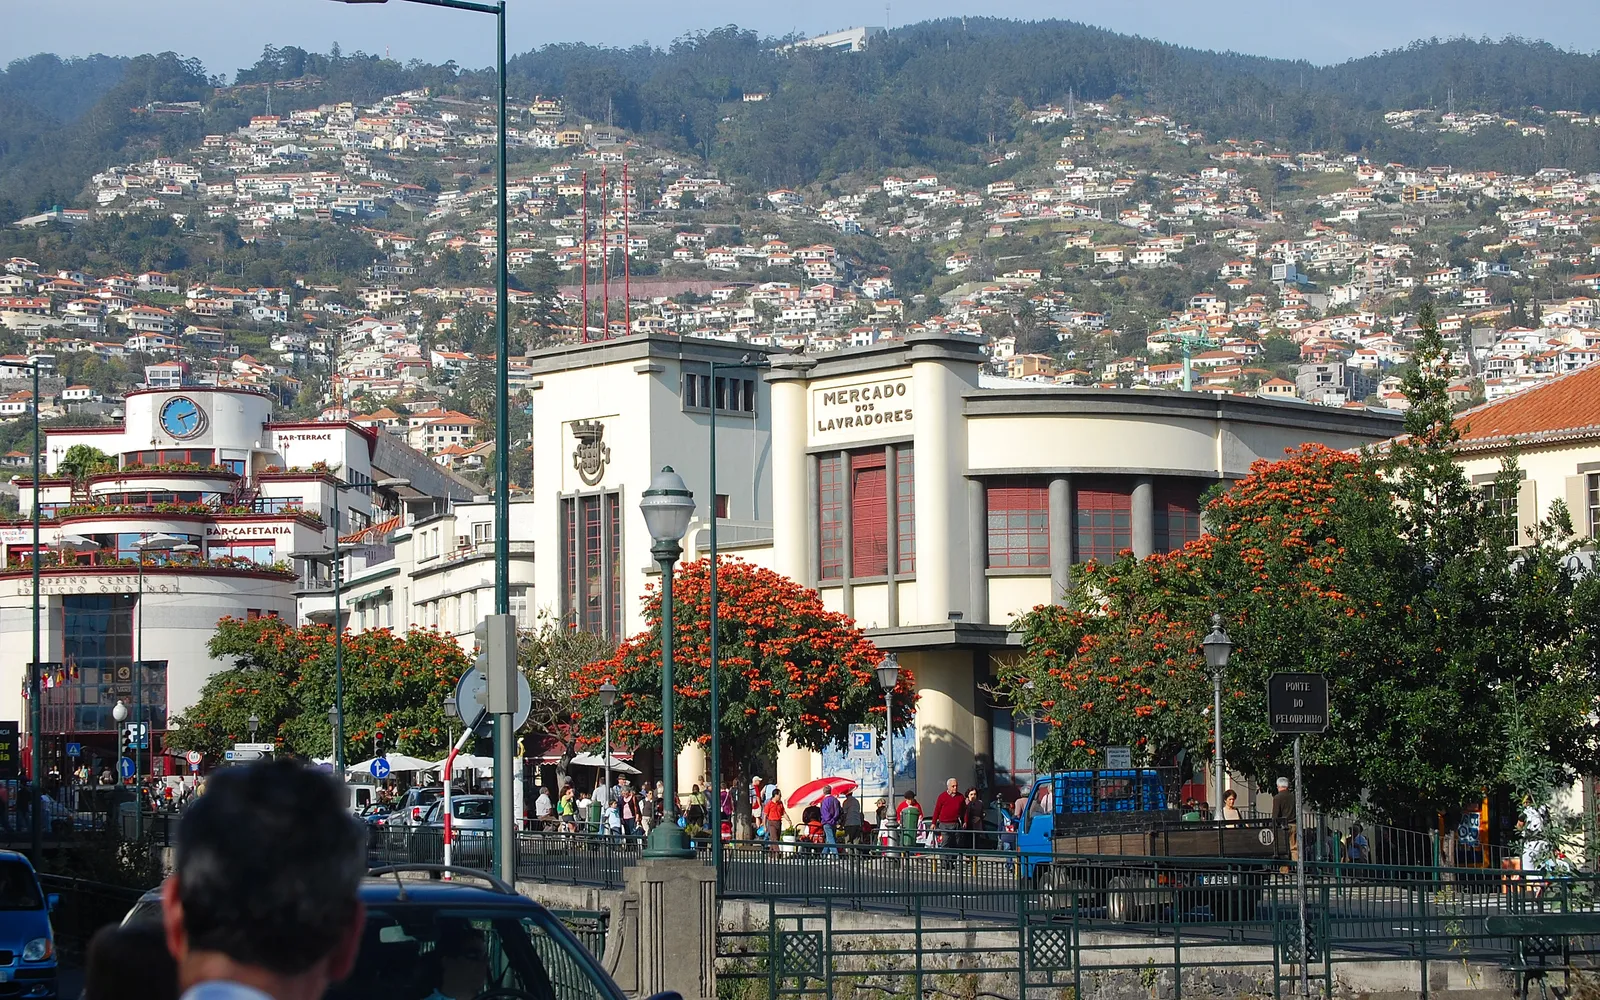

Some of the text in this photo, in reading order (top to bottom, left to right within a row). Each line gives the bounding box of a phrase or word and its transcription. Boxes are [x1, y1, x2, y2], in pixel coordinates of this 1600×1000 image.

[823, 382, 906, 407] MERCADO
[855, 403, 874, 412] DOS
[818, 409, 913, 432] LAVRADORES
[206, 527, 291, 536] BAR-CAFETARIA
[97, 576, 149, 585] CENTER
[1285, 681, 1311, 691] PONTE
[1293, 698, 1304, 708] DO
[1275, 714, 1322, 723] PELOURINHO
[855, 734, 865, 746] P
[1261, 830, 1272, 844] 80
